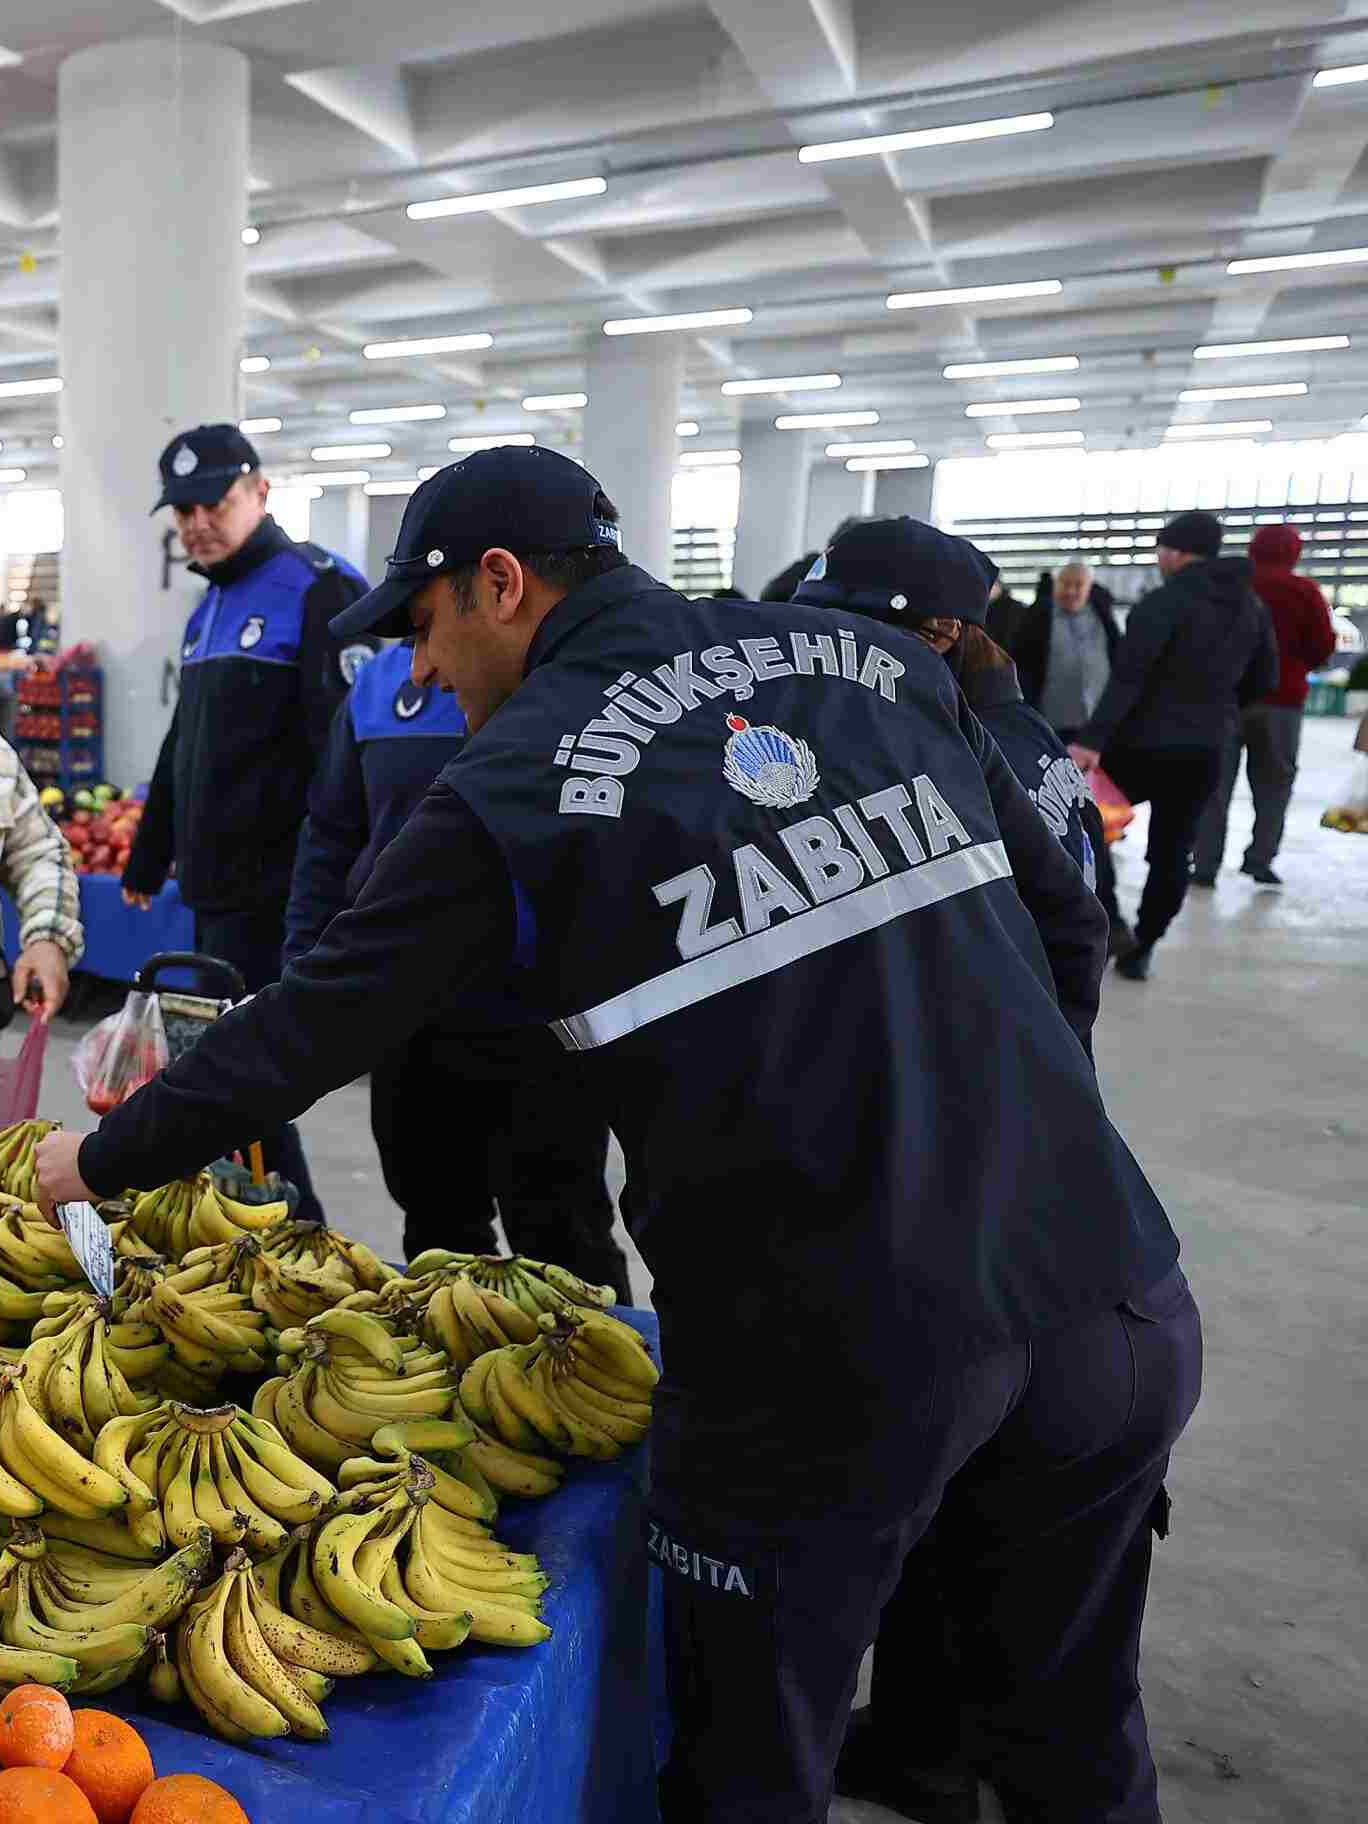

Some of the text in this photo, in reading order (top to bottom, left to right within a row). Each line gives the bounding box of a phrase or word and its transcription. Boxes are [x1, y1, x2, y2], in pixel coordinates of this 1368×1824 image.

[553, 629, 907, 819] BÜYÜKŞEHİR
[651, 773, 974, 961] ZABITA
[647, 1521, 750, 1597] ZABITA
